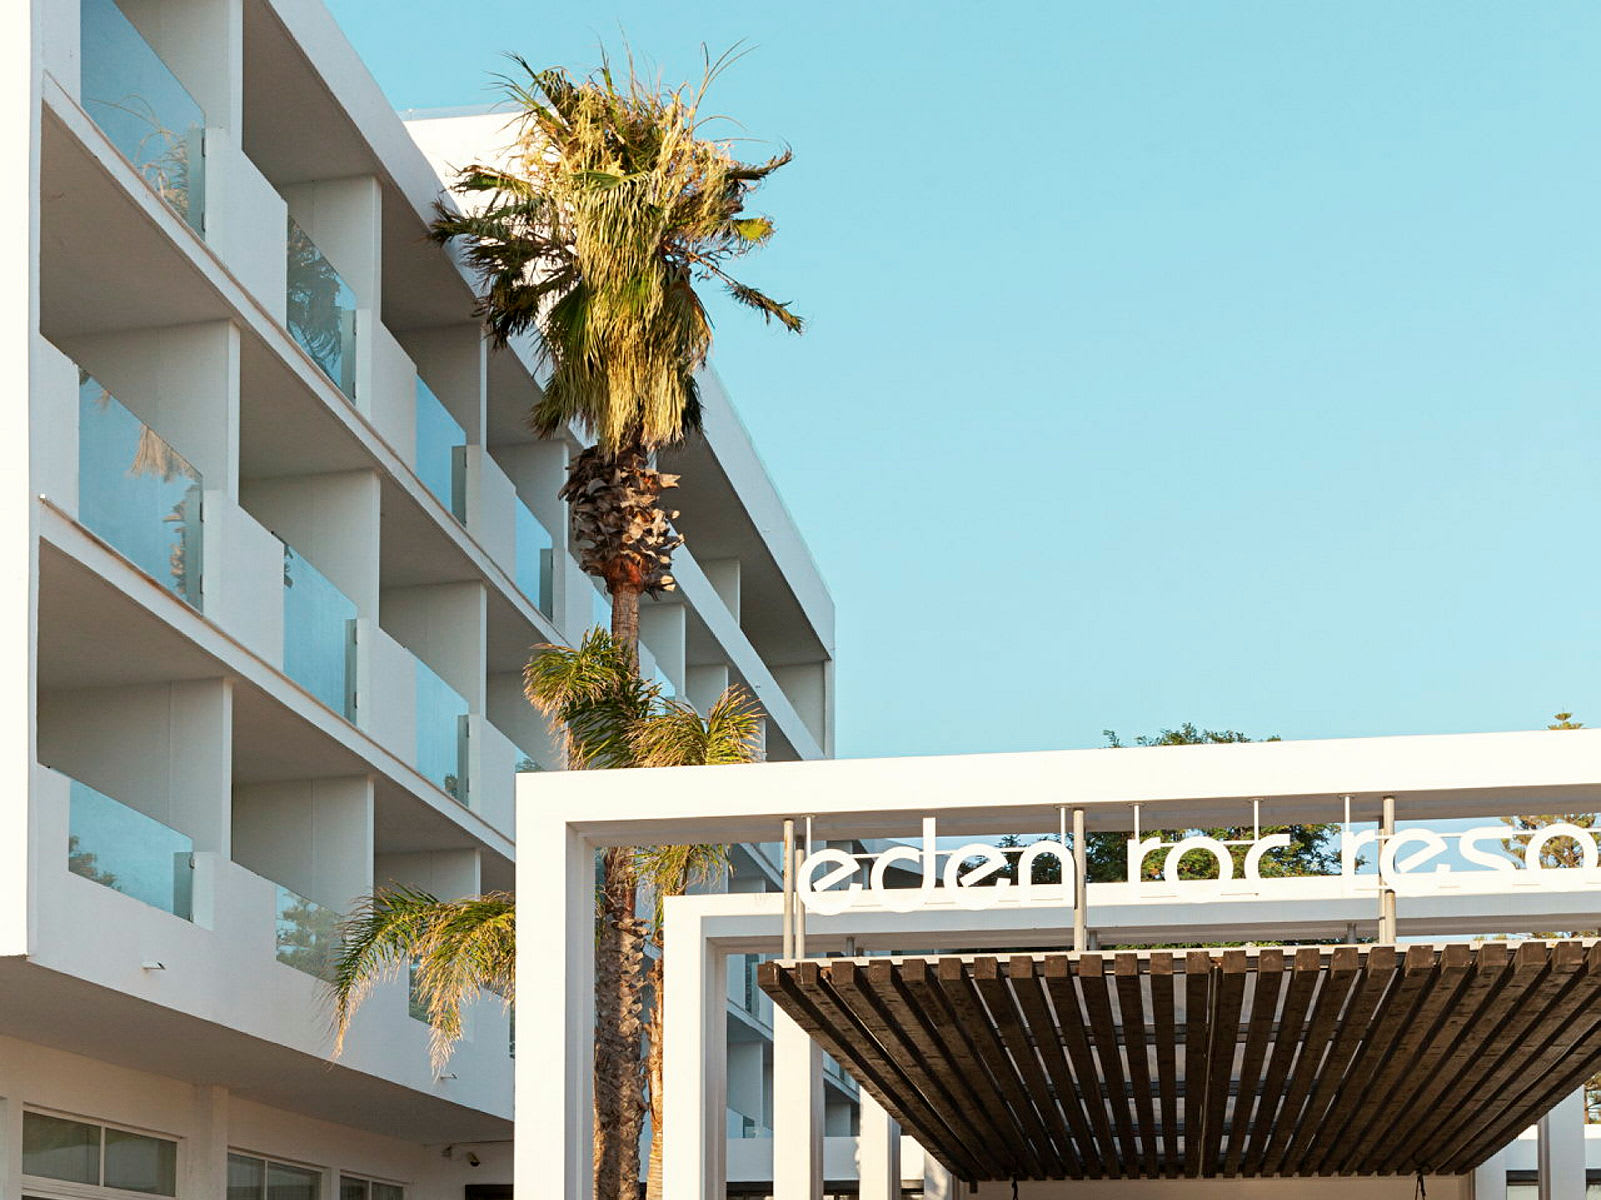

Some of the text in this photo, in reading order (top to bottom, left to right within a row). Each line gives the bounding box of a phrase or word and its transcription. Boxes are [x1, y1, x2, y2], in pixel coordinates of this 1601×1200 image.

[797, 817, 1600, 915] eden roc reso
